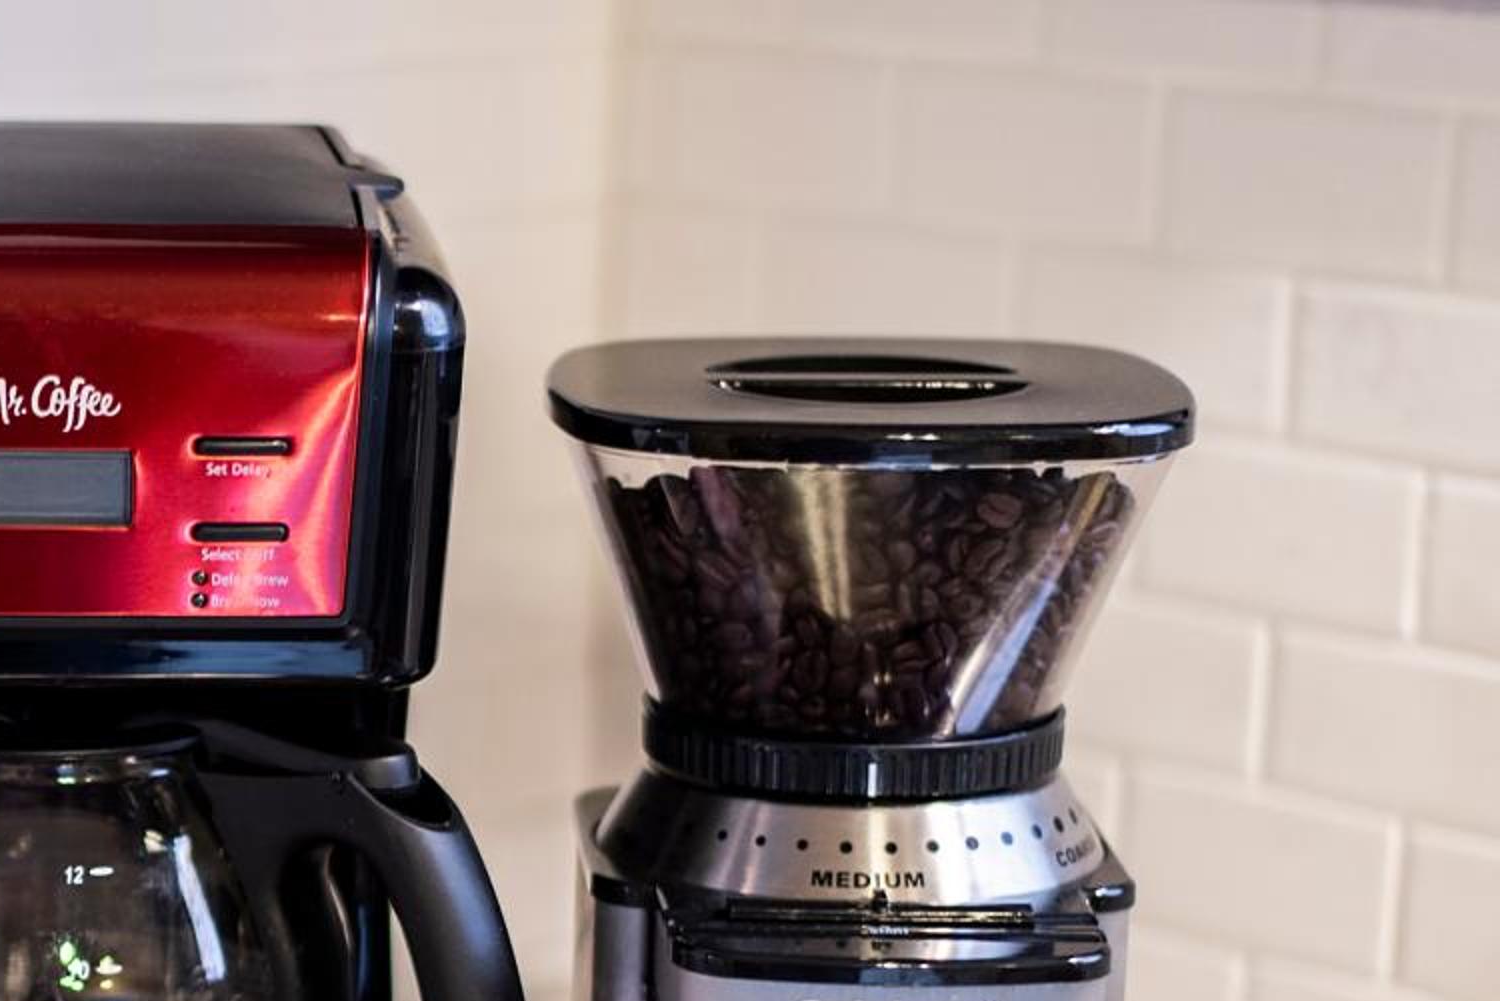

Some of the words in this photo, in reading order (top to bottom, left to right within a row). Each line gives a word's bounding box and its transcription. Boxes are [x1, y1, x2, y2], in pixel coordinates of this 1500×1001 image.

[31, 373, 122, 434] Coffee
[205, 462, 228, 477] Set
[201, 547, 241, 561] Select
[65, 865, 84, 885] 12
[810, 869, 926, 889] MEDIUM
